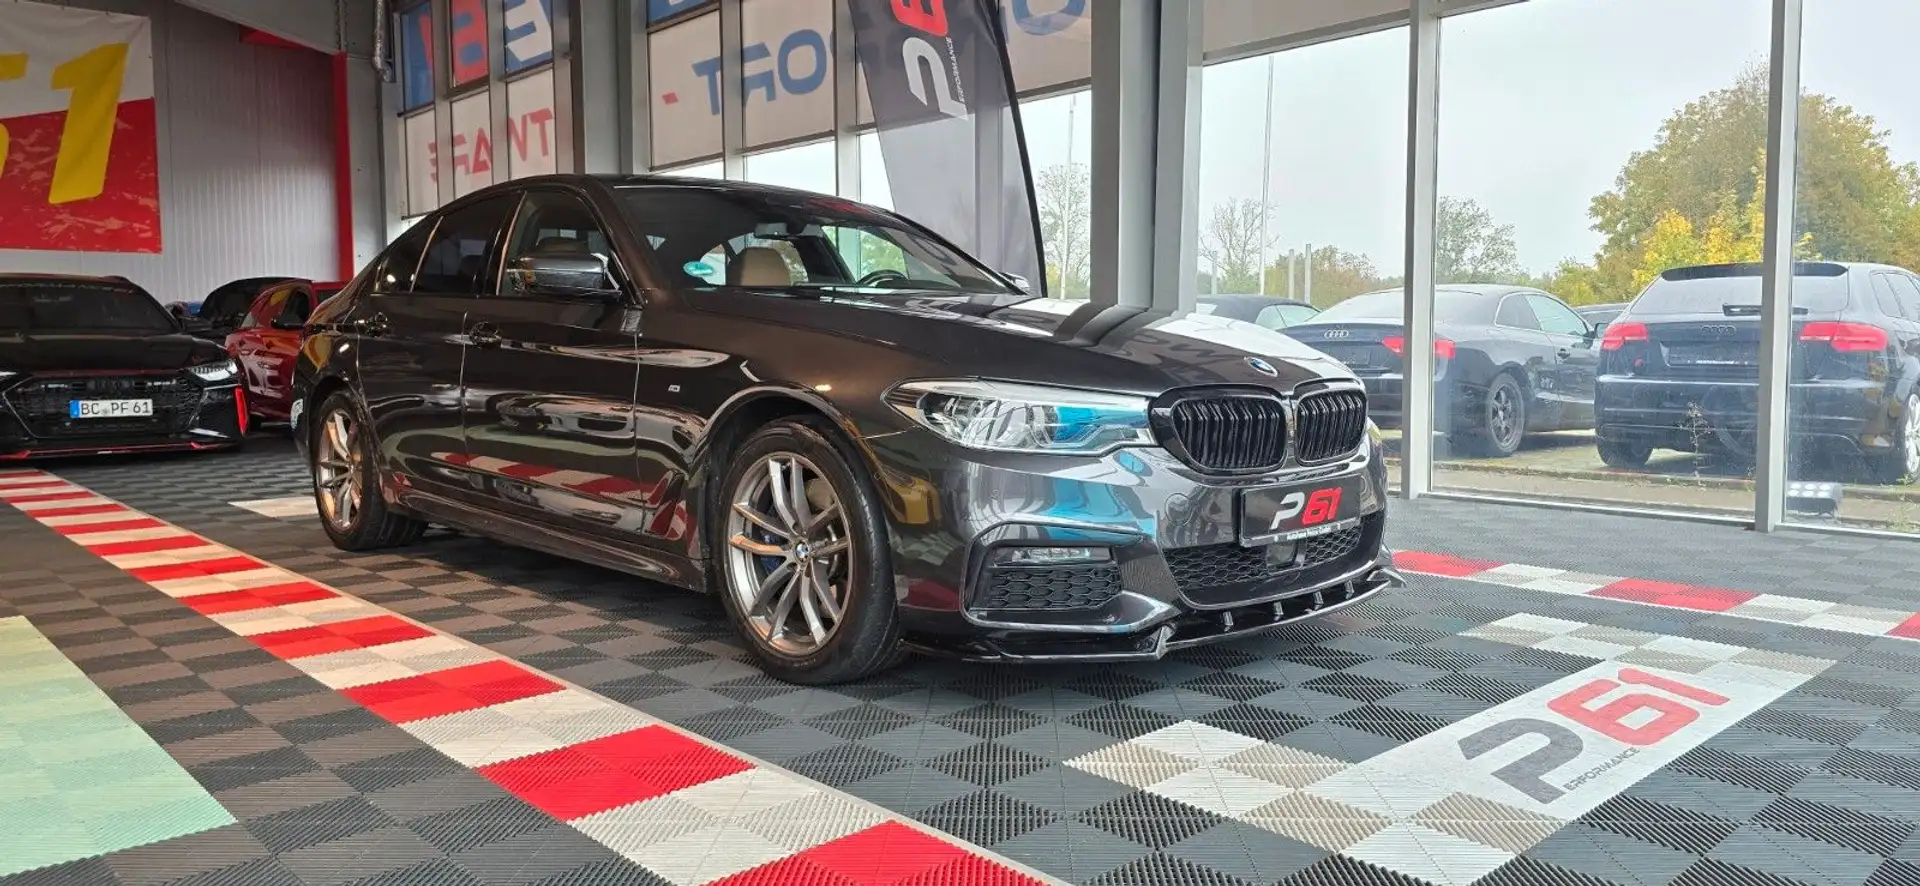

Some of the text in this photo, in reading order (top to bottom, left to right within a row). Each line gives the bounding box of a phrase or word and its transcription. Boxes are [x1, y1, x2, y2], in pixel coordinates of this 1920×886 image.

[81, 401, 150, 415] BC PF 61
[1270, 486, 1343, 531] P61
[1457, 667, 1731, 805] P61
